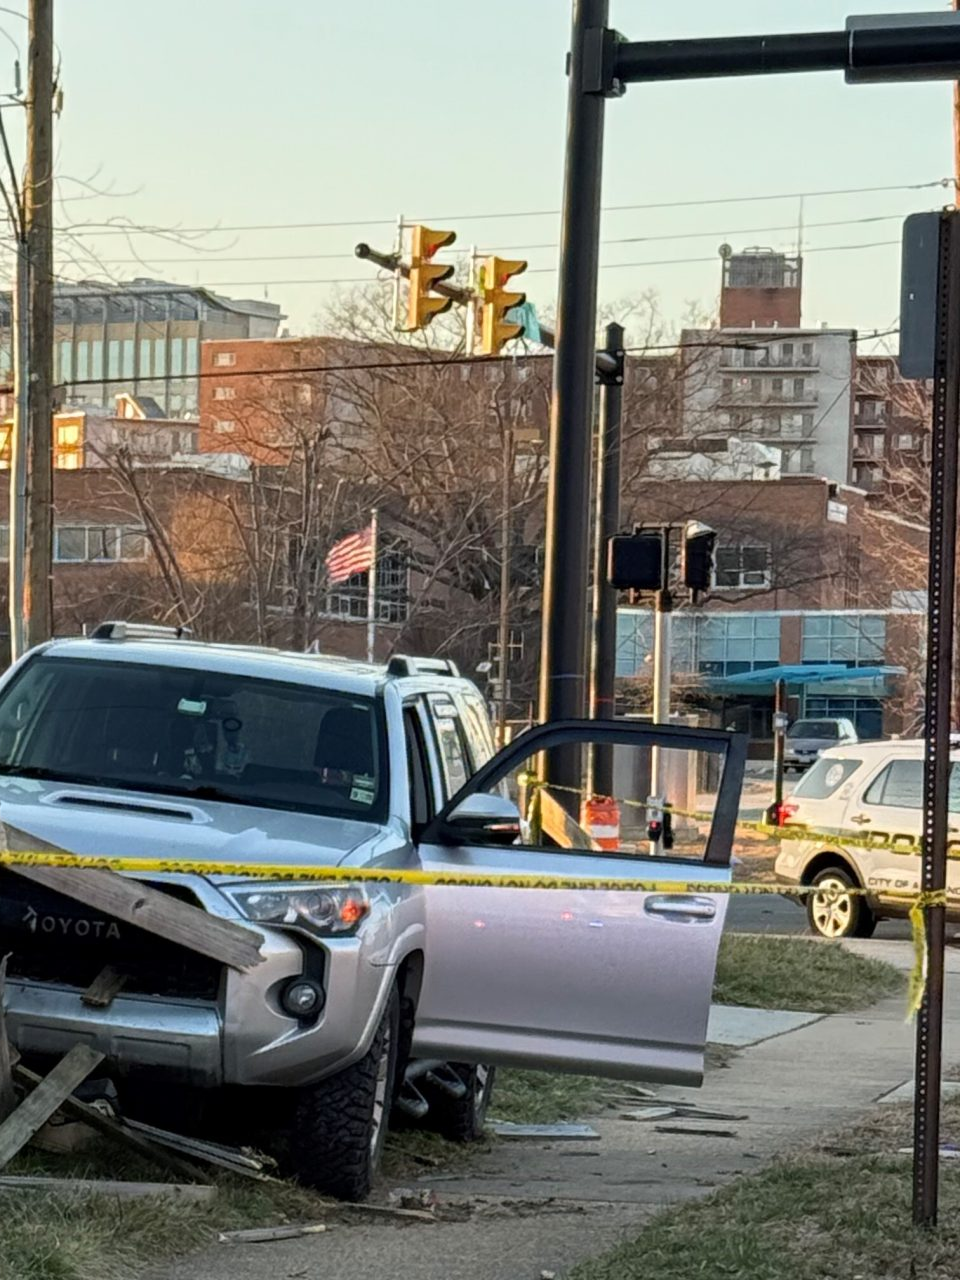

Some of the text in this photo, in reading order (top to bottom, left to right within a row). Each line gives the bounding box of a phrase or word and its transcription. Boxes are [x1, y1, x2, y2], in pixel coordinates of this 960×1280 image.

[868, 877, 892, 888] CITY
[894, 879, 909, 889] OF
[22, 906, 121, 940] TOYOTA
